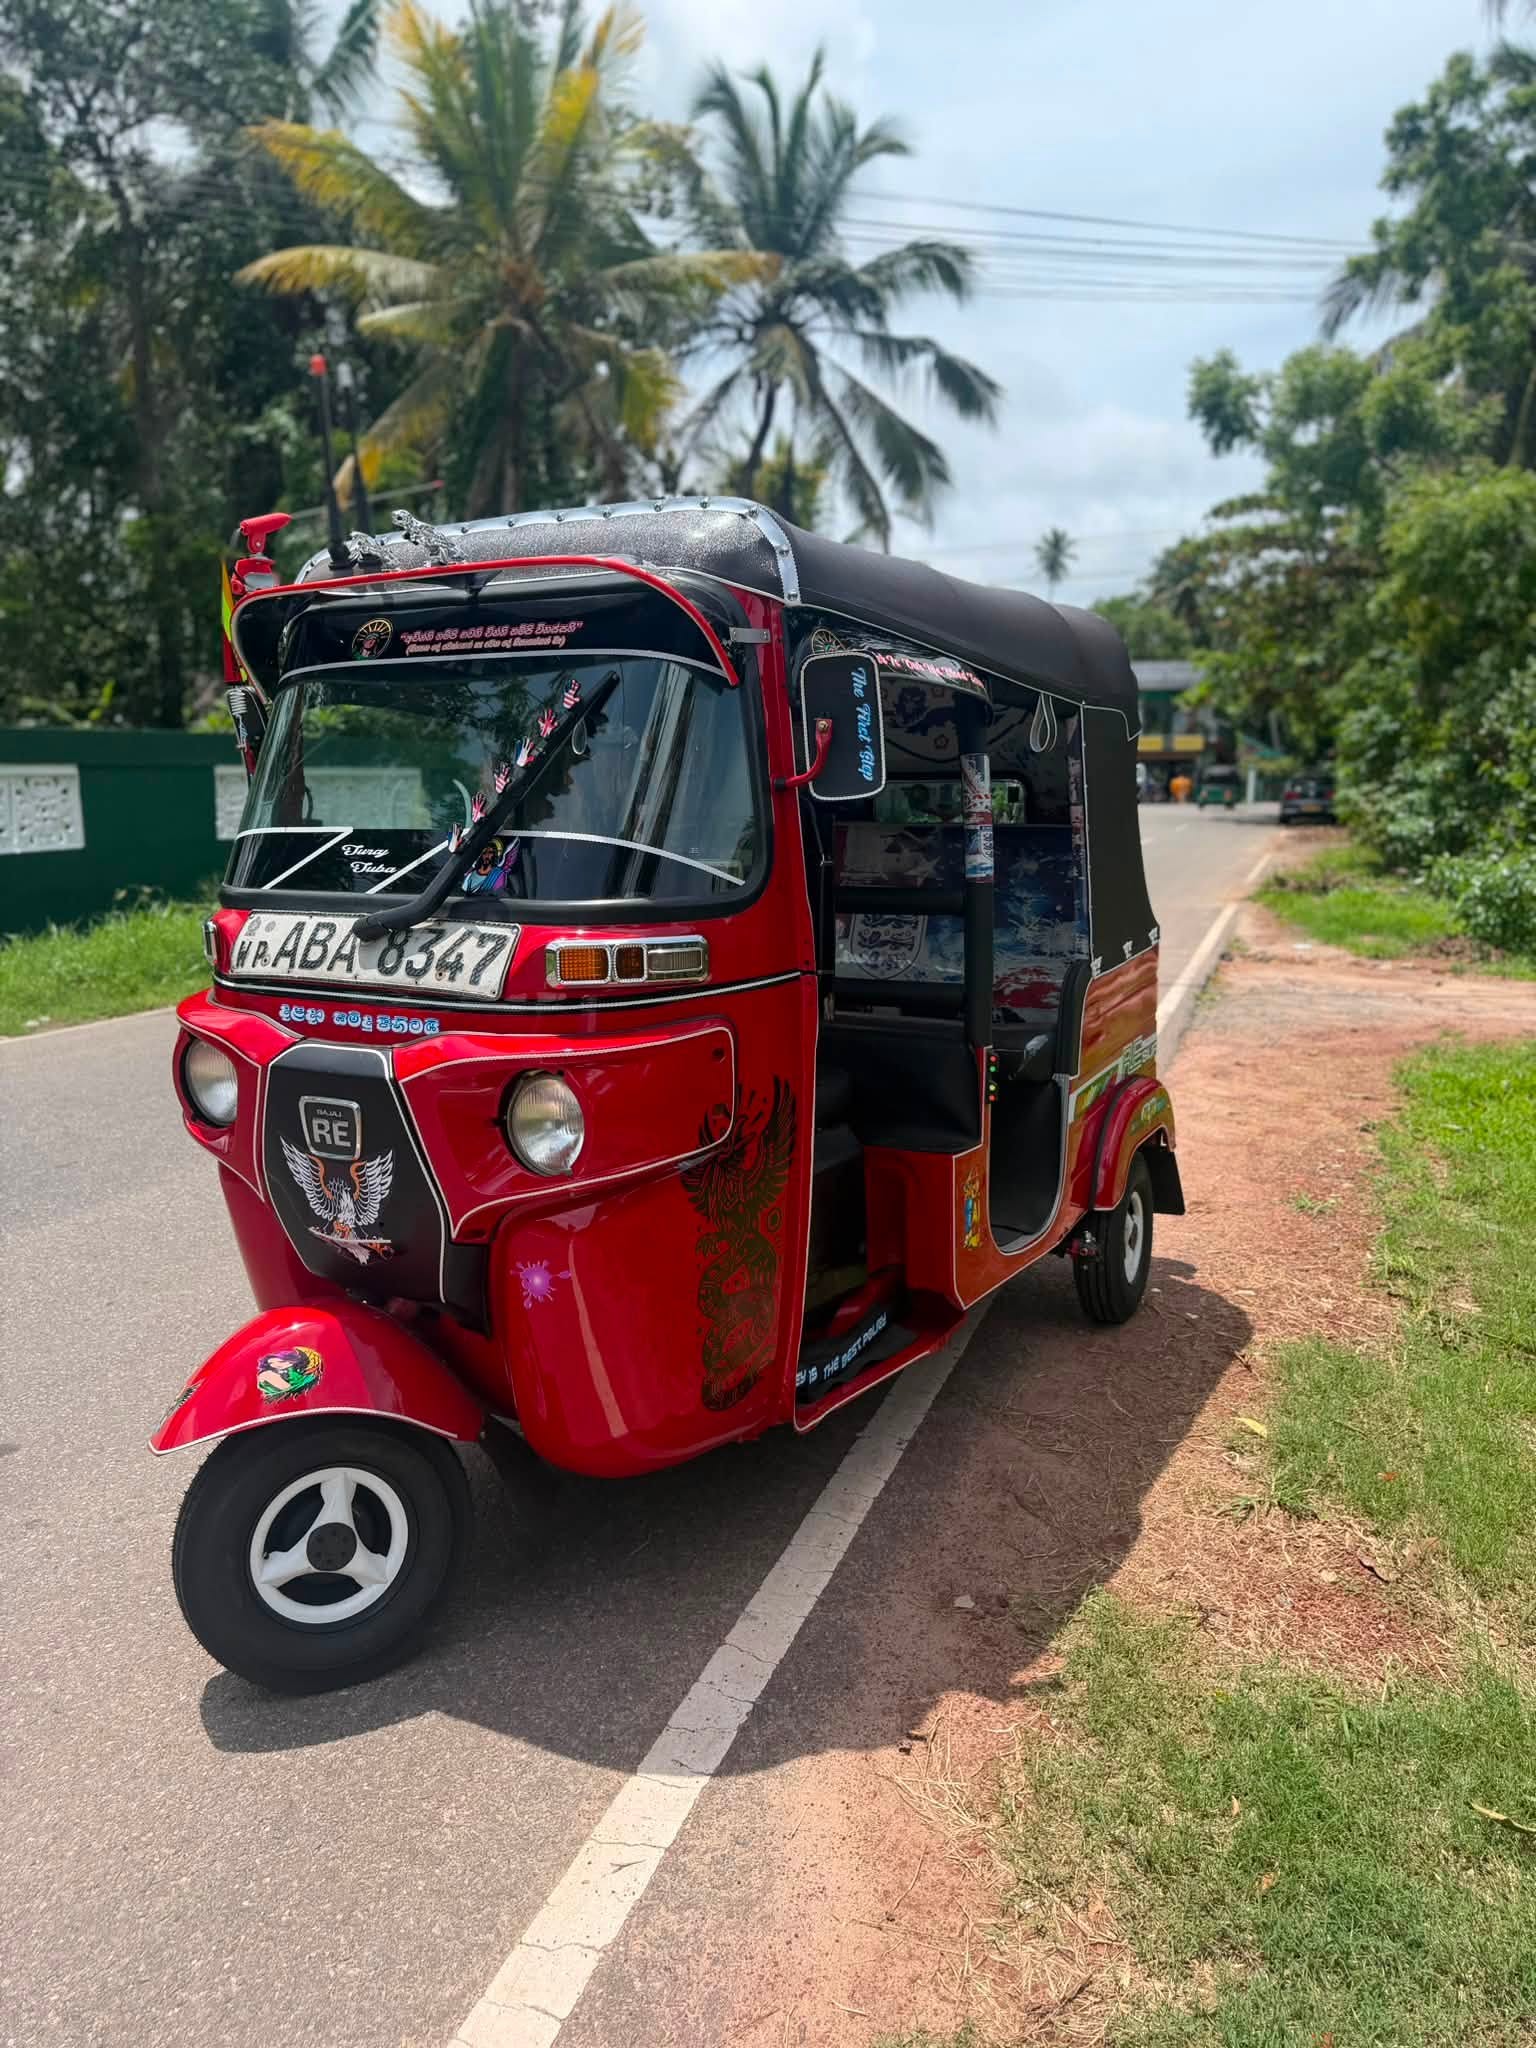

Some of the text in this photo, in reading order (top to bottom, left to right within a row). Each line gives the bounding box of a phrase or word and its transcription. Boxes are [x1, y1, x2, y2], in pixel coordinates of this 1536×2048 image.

[851, 667, 867, 698] The
[271, 920, 359, 973] ABA
[377, 928, 510, 986] 8347
[311, 1117, 352, 1148] RE
[823, 1355, 840, 1380] THE
[841, 1336, 863, 1369] BEST
